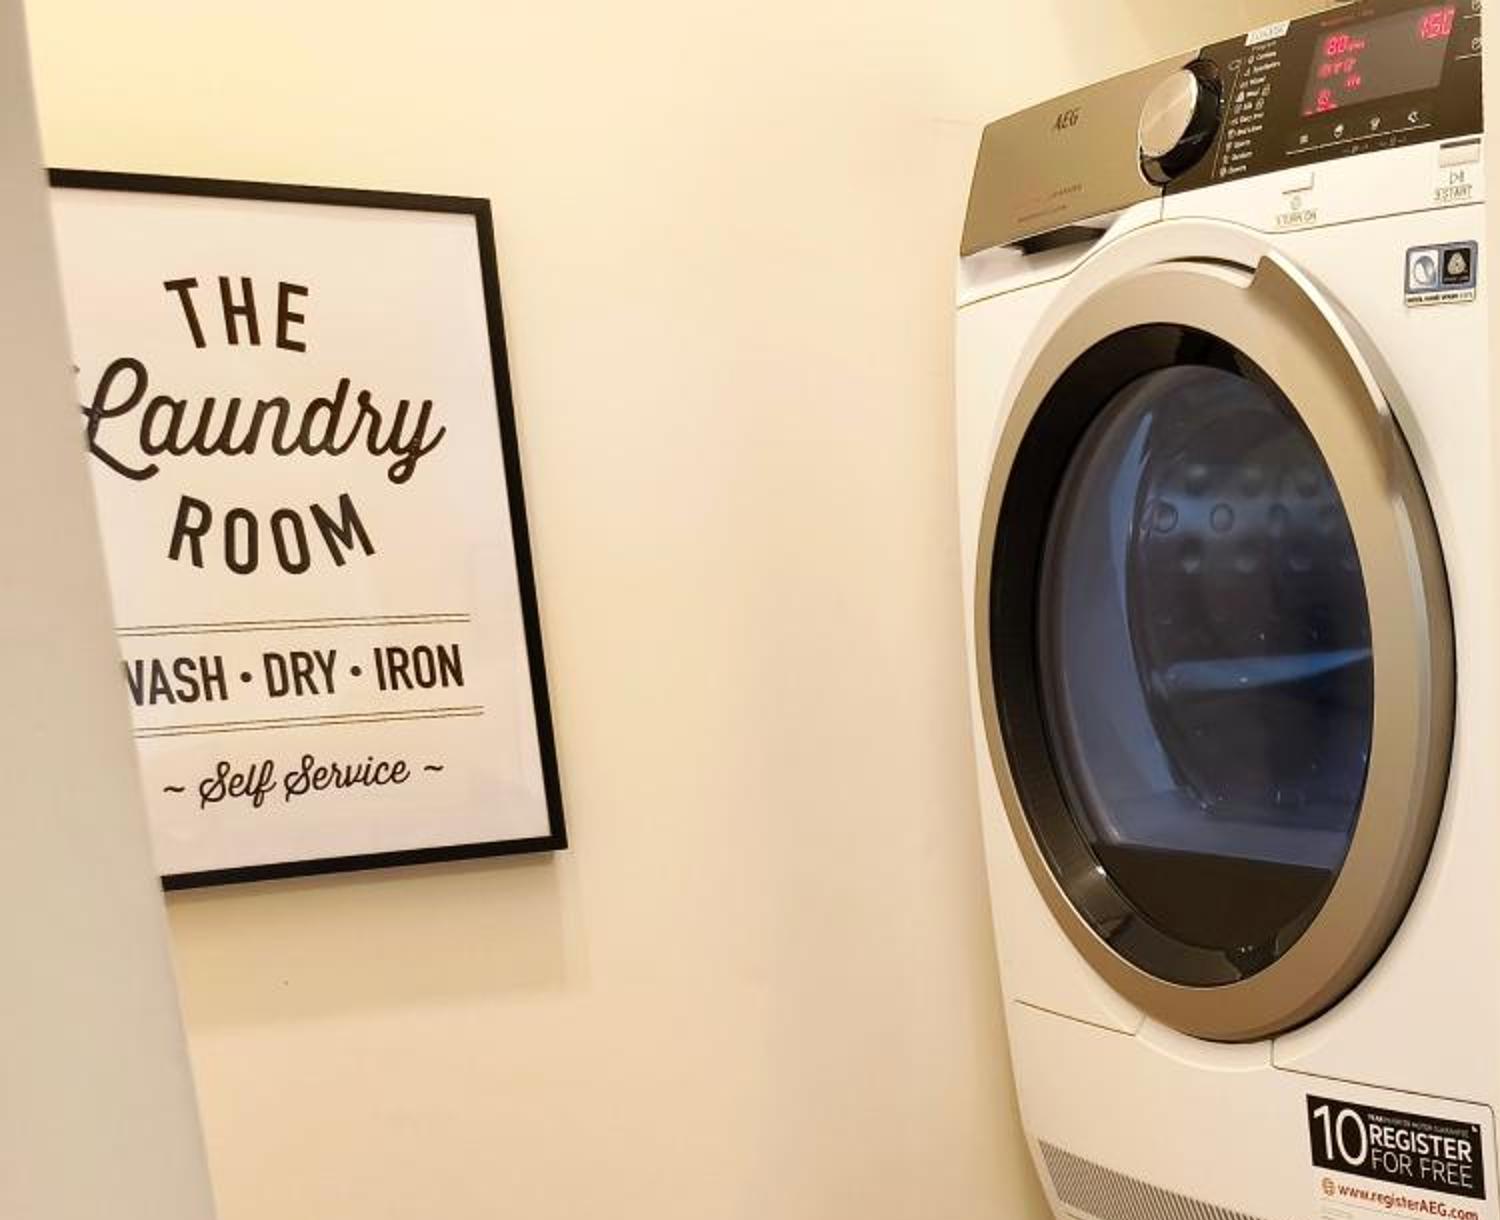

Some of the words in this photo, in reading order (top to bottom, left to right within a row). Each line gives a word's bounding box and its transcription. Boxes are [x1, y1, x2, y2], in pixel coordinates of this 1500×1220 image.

[1054, 107, 1081, 131] AEG
[163, 275, 309, 353] THE
[80, 356, 447, 484] Laundry
[168, 492, 376, 575] ROOM
[262, 649, 337, 698] DRY
[373, 643, 465, 691] IRON
[199, 759, 278, 809] Self
[284, 753, 411, 802] Service
[1312, 1104, 1369, 1167] 10
[1368, 1123, 1473, 1163] REGISTER
[1370, 1147, 1414, 1177] FOR
[1419, 1157, 1473, 1189] FREE
